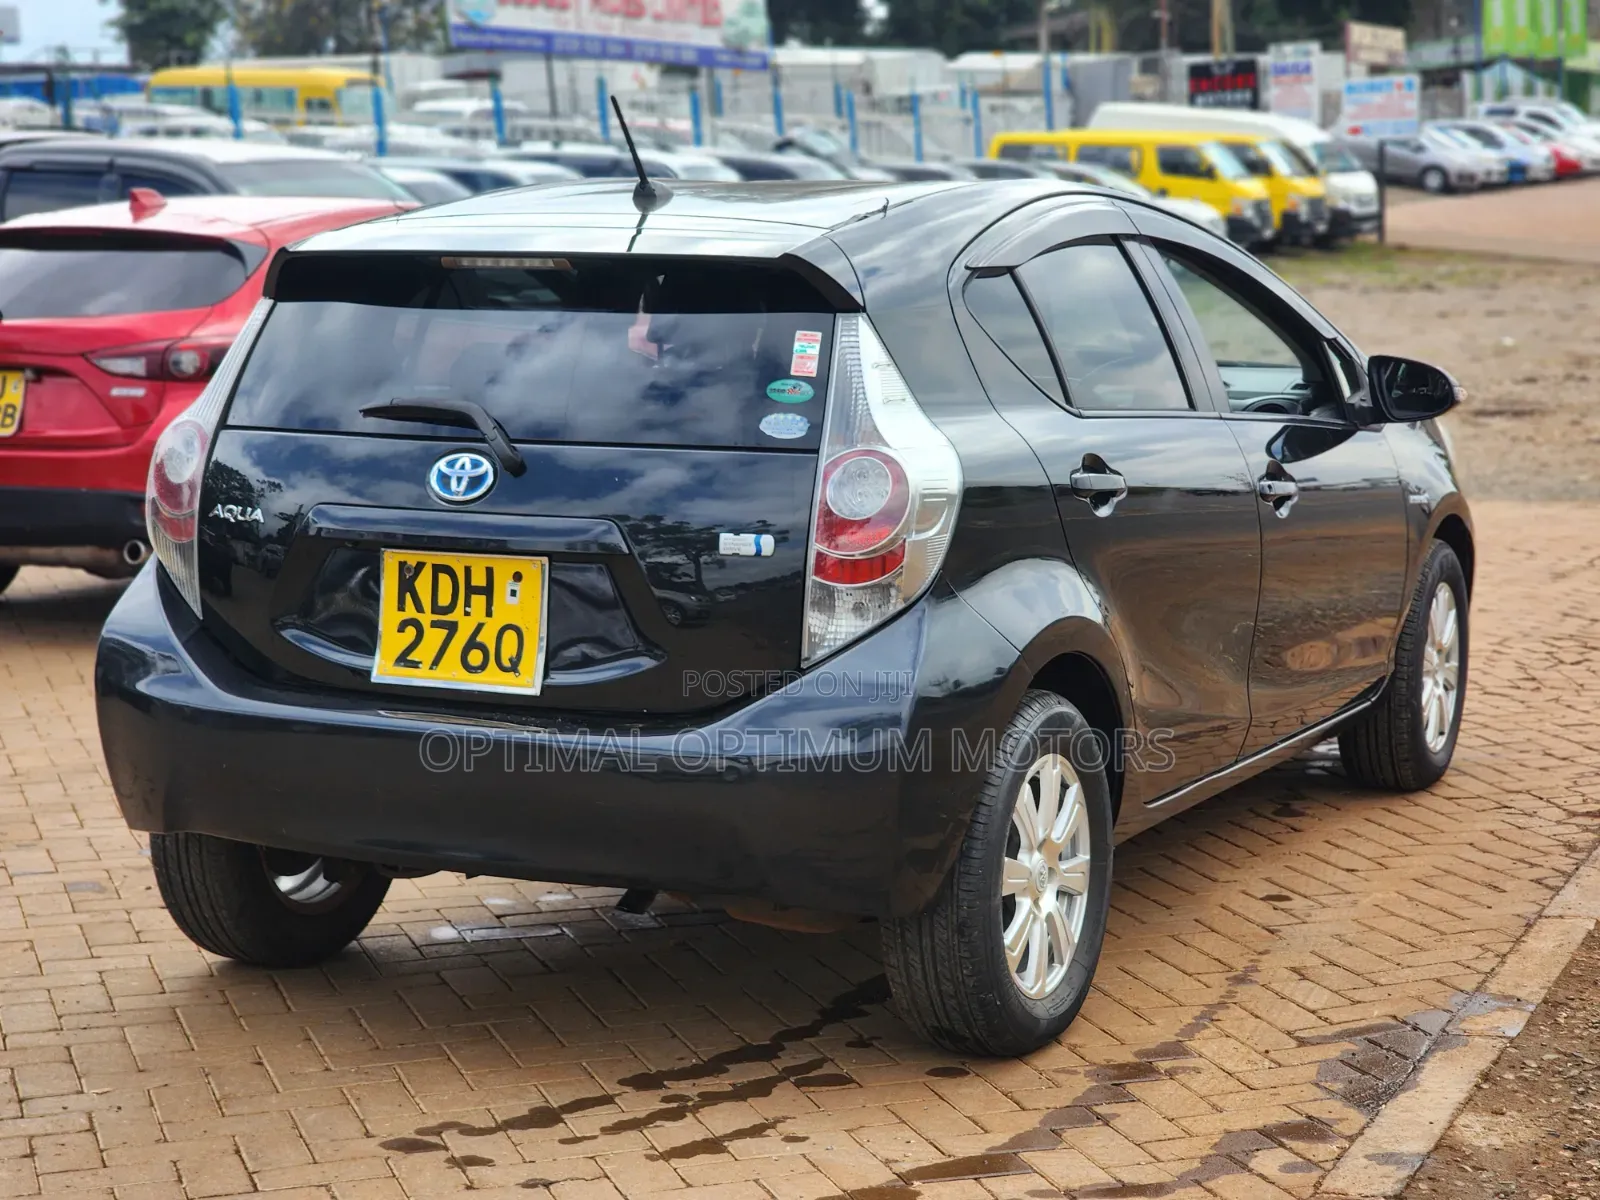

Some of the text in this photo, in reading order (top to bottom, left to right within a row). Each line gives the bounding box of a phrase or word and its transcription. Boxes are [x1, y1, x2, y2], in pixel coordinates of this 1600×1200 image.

[208, 503, 265, 523] AQUA
[397, 560, 495, 618] KDH
[393, 617, 525, 677] 276Q
